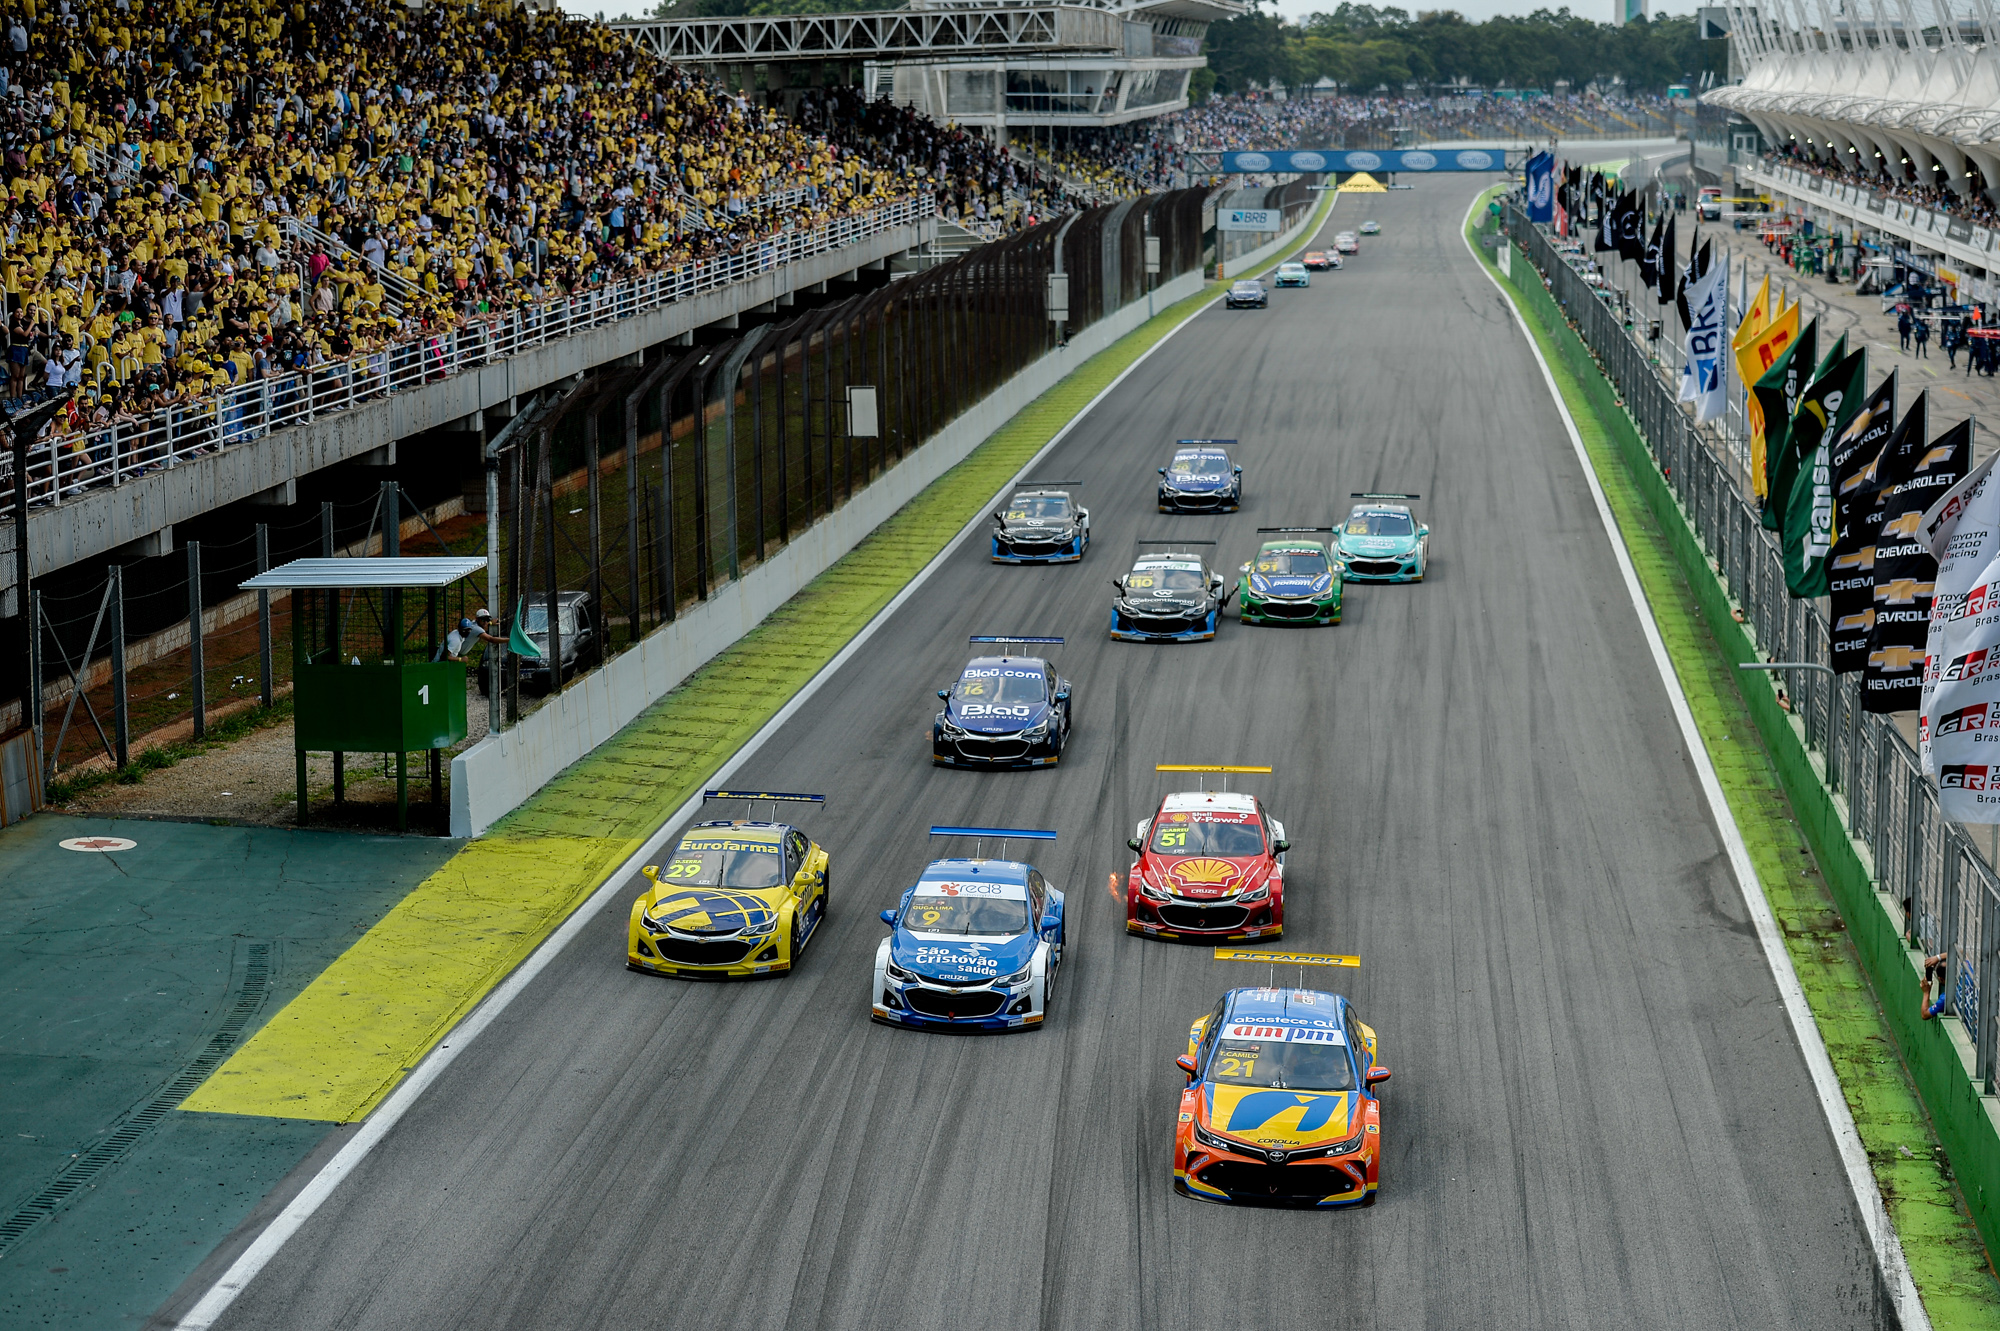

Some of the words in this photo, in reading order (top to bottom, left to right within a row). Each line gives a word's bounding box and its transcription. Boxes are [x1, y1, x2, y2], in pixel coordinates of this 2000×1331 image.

[1245, 212, 1267, 223] BRB
[1951, 531, 1988, 542] TOYOTA
[1260, 564, 1278, 572] 91
[1129, 579, 1153, 587] 110
[1950, 596, 1984, 620] GR
[1942, 660, 1984, 681] GR
[418, 685, 429, 705] 1
[964, 686, 983, 695] 16
[1937, 713, 1984, 736] GR
[1941, 773, 1985, 790] GR
[1160, 832, 1187, 847] 51
[679, 840, 779, 854] Eurofarma
[666, 864, 701, 878] 29
[960, 884, 1002, 894] red8
[922, 911, 941, 926] 9
[917, 947, 949, 955] São
[915, 954, 998, 967] Cristóvão
[958, 964, 997, 976] saúde
[1233, 1025, 1335, 1042] ampm
[1220, 1051, 1258, 1059] T.CAMILO
[1219, 1058, 1255, 1078] 21
